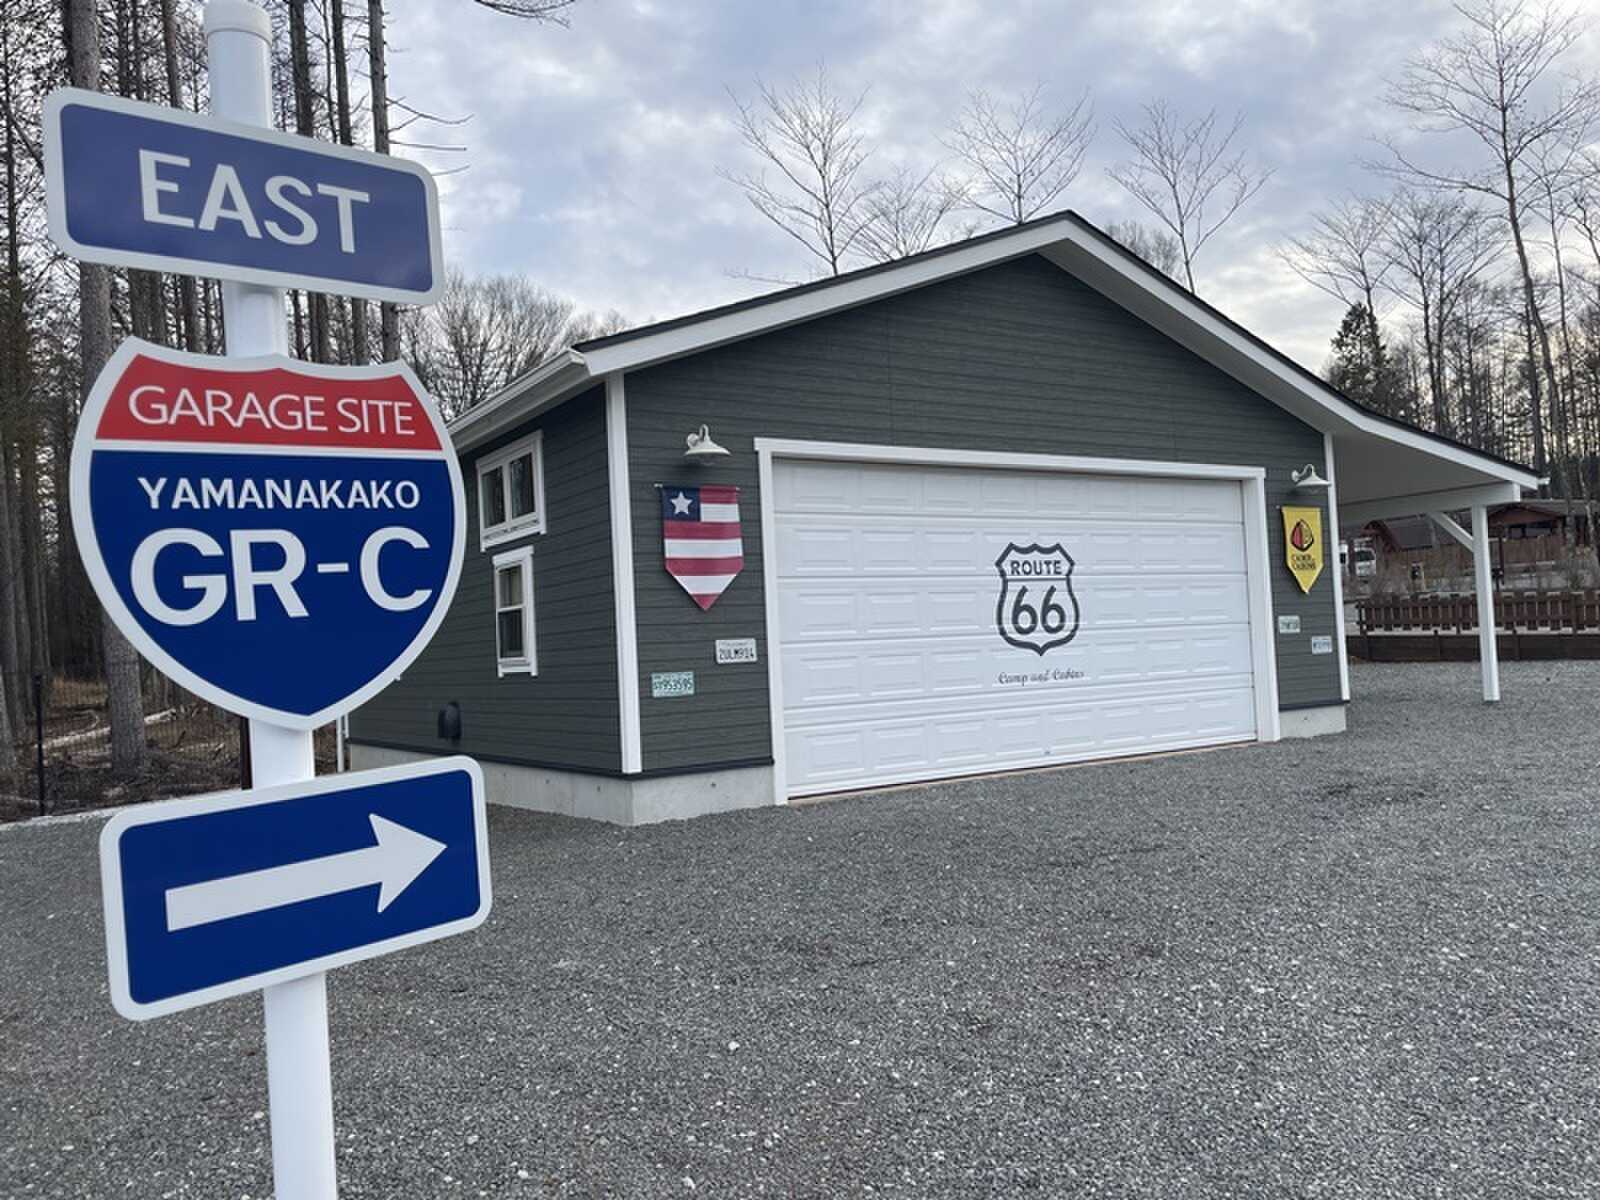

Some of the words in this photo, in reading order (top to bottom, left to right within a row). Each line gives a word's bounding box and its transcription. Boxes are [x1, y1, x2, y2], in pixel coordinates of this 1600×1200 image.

[138, 149, 370, 254] EAST
[128, 385, 328, 432] GARAGE
[336, 398, 416, 436] SITE
[138, 476, 420, 509] YAMANAKAKO
[130, 526, 434, 627] GR-C
[1010, 559, 1063, 576] ROUTE
[1011, 585, 1066, 635] 66
[998, 671, 1028, 687] Camp
[1030, 668, 1050, 681] and
